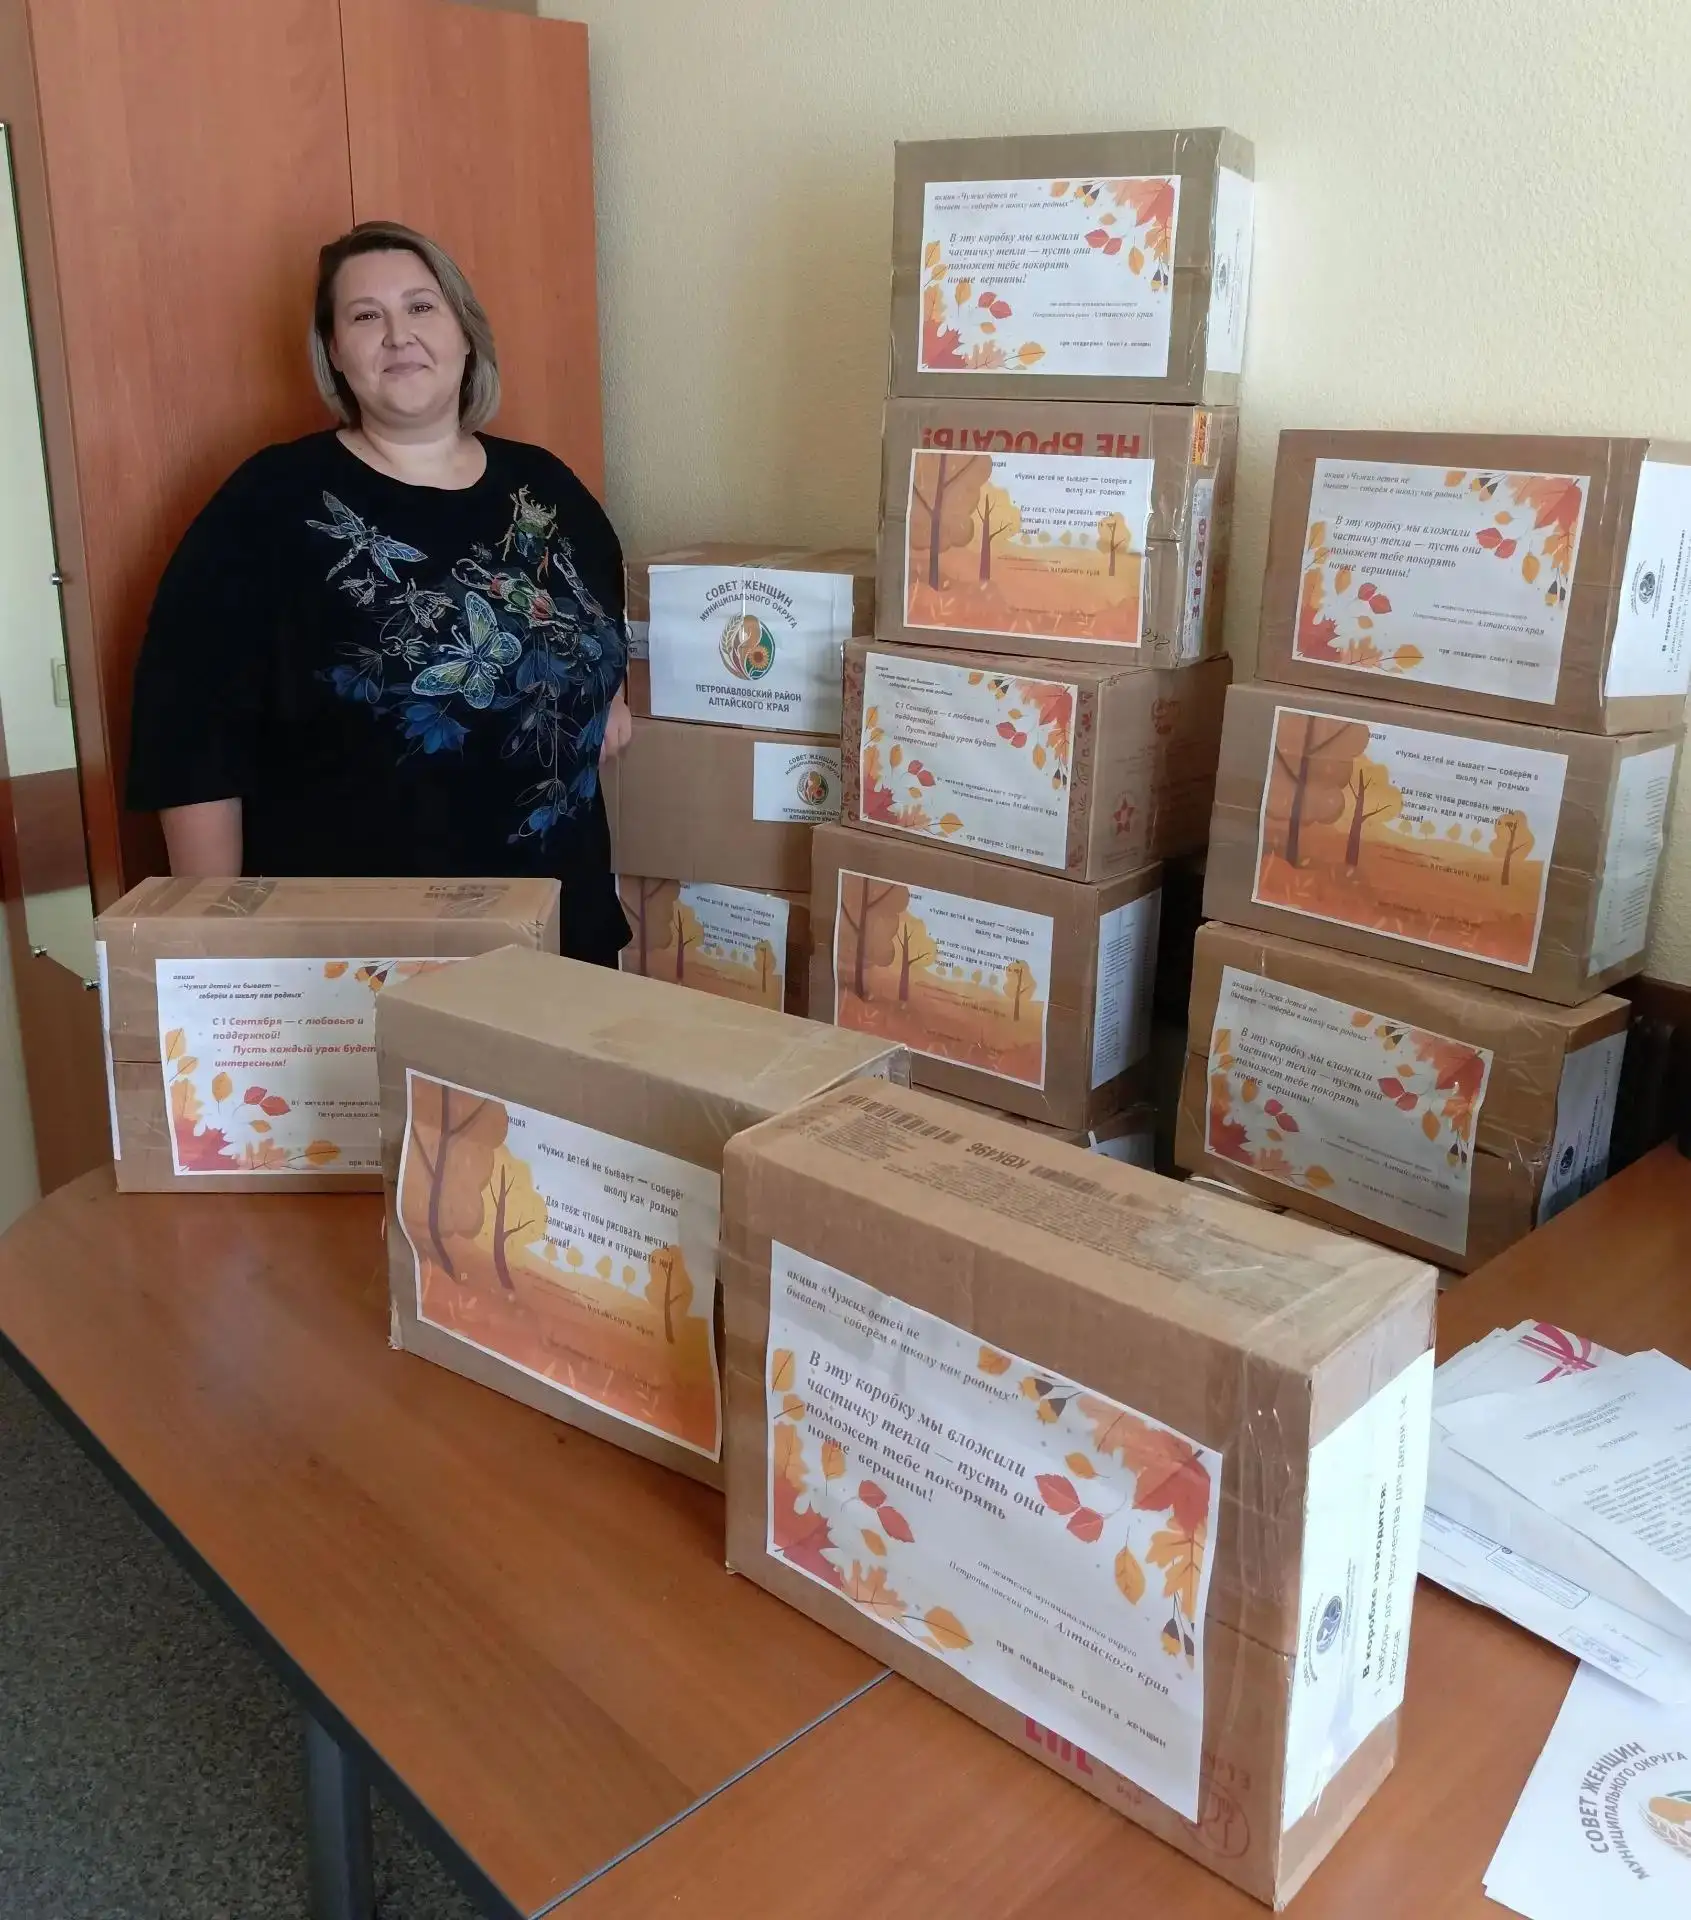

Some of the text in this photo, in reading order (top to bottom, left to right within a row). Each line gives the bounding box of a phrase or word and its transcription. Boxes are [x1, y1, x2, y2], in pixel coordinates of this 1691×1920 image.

[923, 429, 1141, 458] НЕ БРОСАТЬ!
[1334, 514, 1470, 537] В эту коробку мы вложили
[1330, 546, 1456, 567] поможет тебе покорять
[1332, 532, 1482, 554] частичку тепла пусть она
[1328, 561, 1410, 577] новые вершины!
[705, 580, 793, 608] СОВЕТ ЖЕНЩИН
[699, 593, 798, 629] МУНИЦИПАЛЬНОГО ОКРУГА
[696, 684, 802, 702] ПЕТРОПАВЛОВСКИЙ РАЙОН
[708, 697, 789, 713] АЛТАЙСКОГО КРАЯ
[788, 754, 807, 765] СОВЕТ
[211, 1017, 219, 1026] С
[228, 1016, 282, 1027] Сентября
[212, 1030, 280, 1041] поддержкой!
[214, 1059, 286, 1068] интересным!
[232, 1043, 376, 1055] Пусть каждый урок будет
[537, 1142, 634, 1182] «Чужих детей не бывает
[603, 1184, 644, 1206] школу как
[545, 1195, 641, 1240] Для чтобы рисовать
[786, 1269, 919, 1339] акция «Чужих детей не
[786, 1284, 825, 1312] бывает
[843, 1316, 887, 1343] соберём
[890, 1338, 897, 1346] в
[899, 1342, 937, 1368] школу
[939, 1362, 961, 1379] как
[808, 1349, 1025, 1477] В эту коробку мы вложили
[805, 1402, 1005, 1519] поможет тебе покорять
[807, 1378, 1044, 1516] частичку тепла пусть она
[807, 1424, 933, 1502] новые вершины!
[1362, 1482, 1387, 1679] В коробке находится:
[1055, 1621, 1168, 1695] Алтайского края
[995, 1639, 1014, 1655] при
[1019, 1653, 1074, 1691] поддержке
[1080, 1689, 1119, 1719] Совета
[1126, 1719, 1166, 1748] женщин
[1579, 1742, 1646, 1853] СОВЕТ ЖЕНЩИН
[1604, 1751, 1688, 1880] МУНИЦИПАЛЬНОГО ОКРУГА
